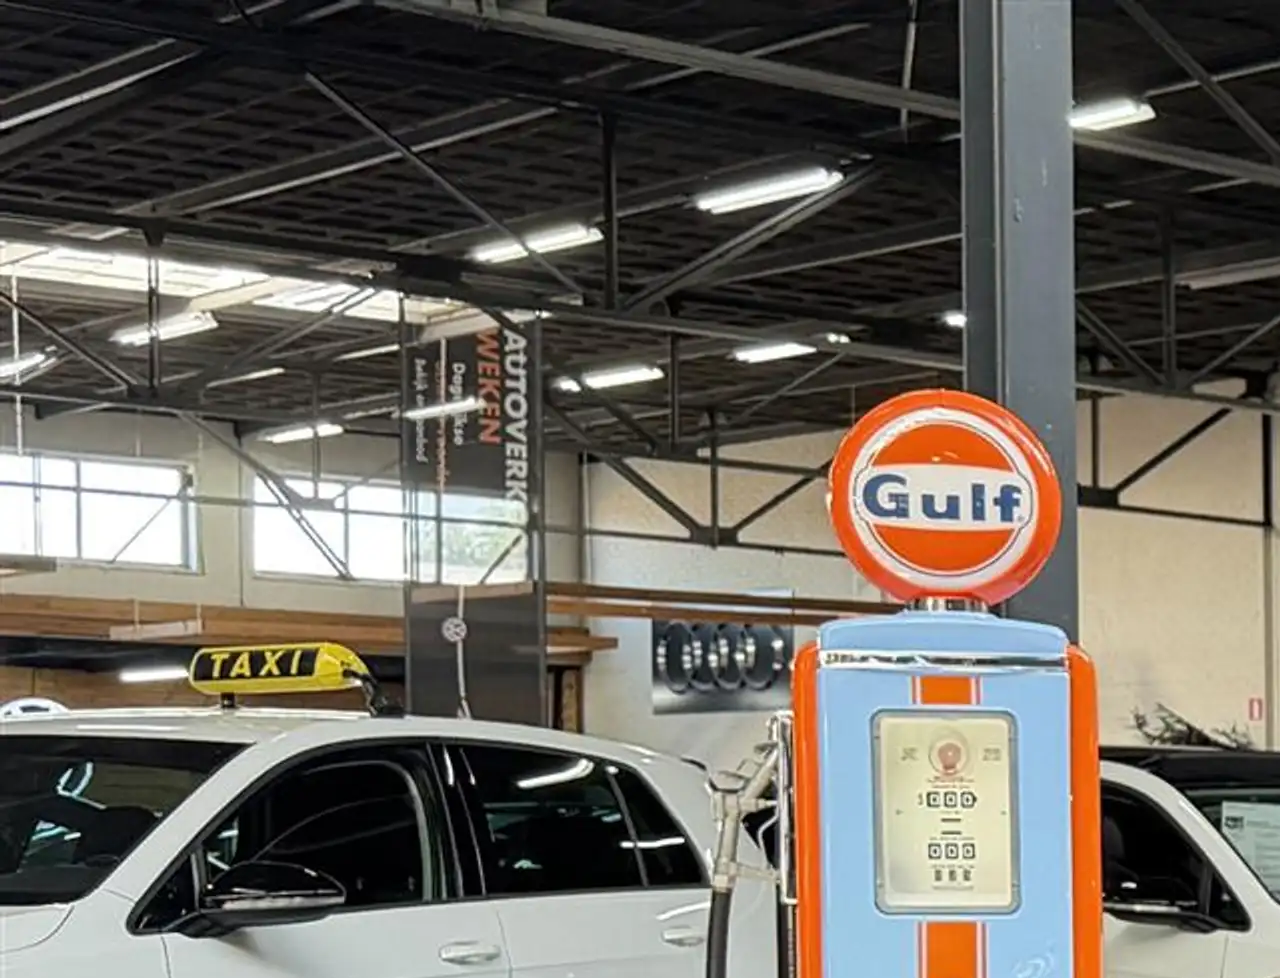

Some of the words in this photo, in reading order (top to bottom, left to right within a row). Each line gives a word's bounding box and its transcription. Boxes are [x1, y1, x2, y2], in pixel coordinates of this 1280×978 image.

[476, 327, 502, 445] WEKEN
[503, 329, 528, 502] AUTOVERK
[862, 473, 1022, 522] Gulf
[210, 649, 303, 678] TAXI
